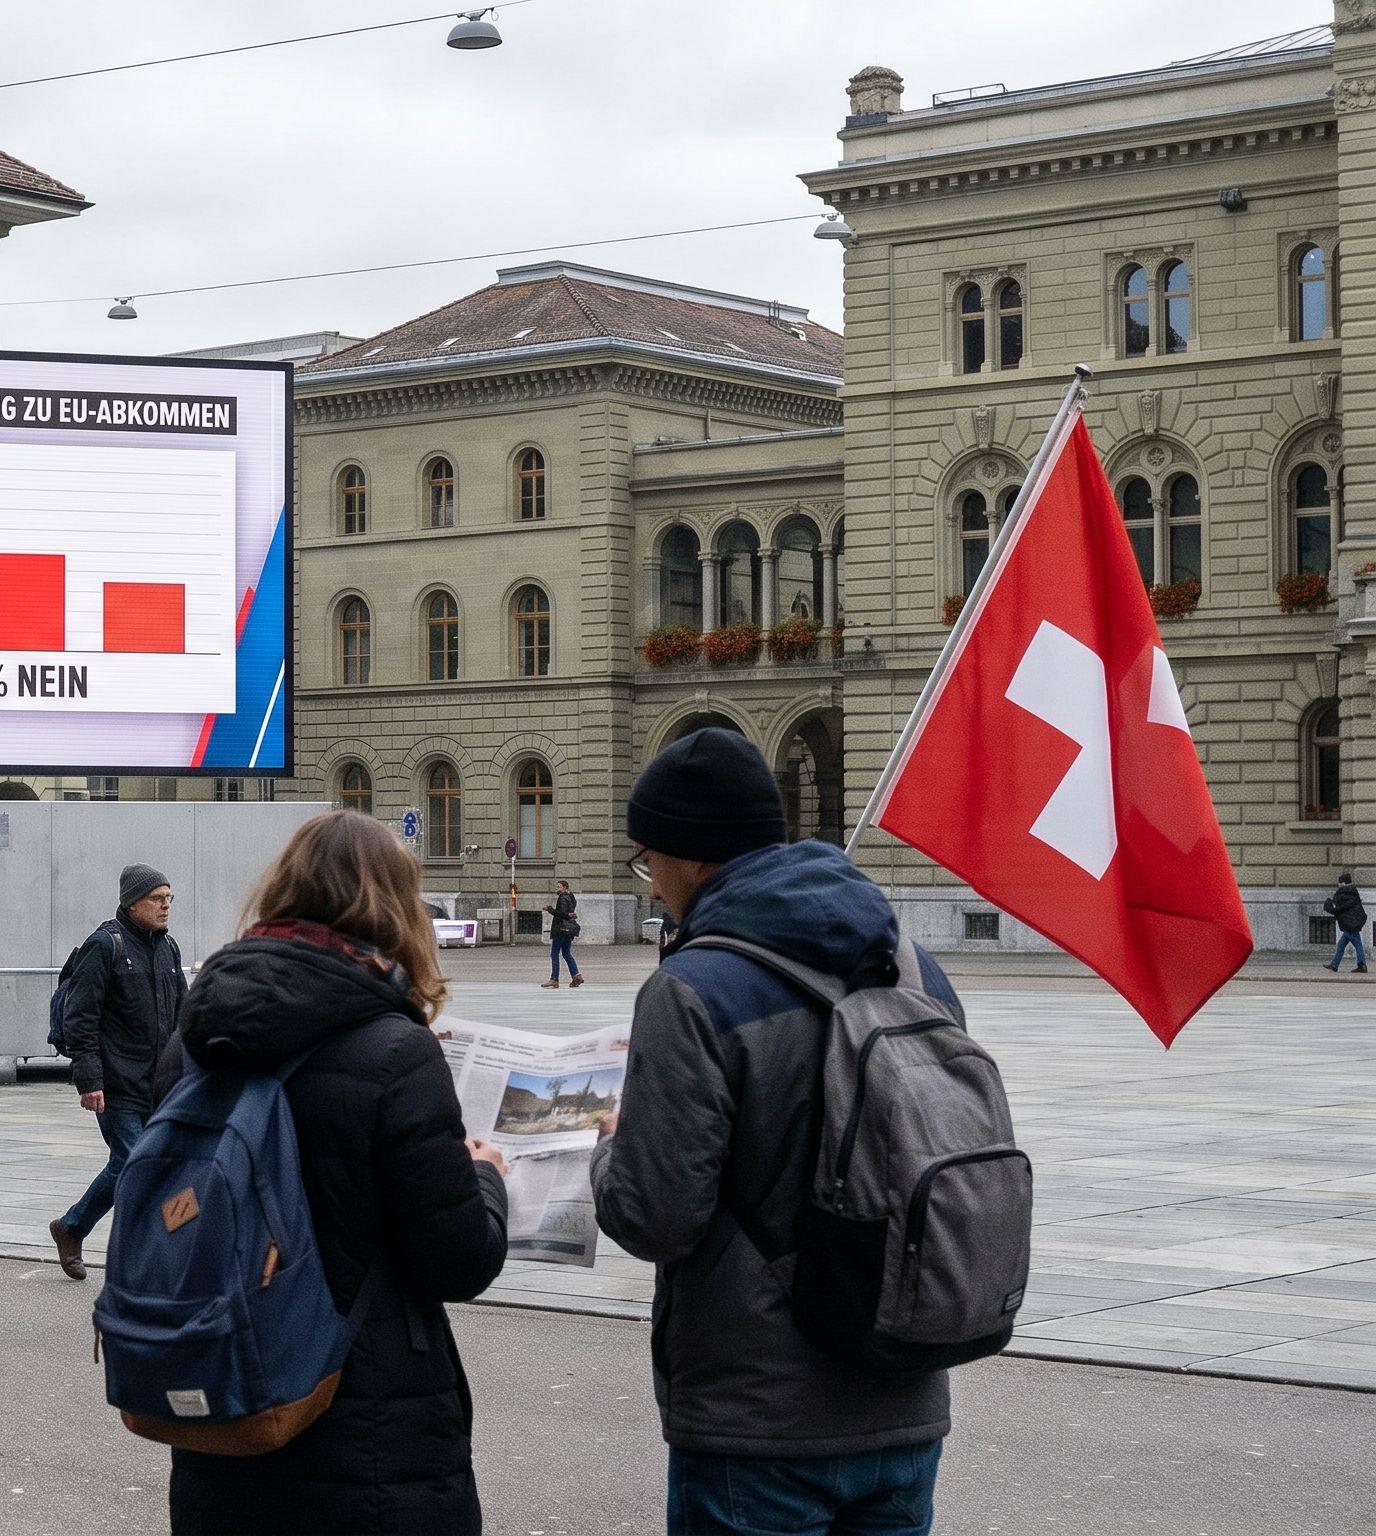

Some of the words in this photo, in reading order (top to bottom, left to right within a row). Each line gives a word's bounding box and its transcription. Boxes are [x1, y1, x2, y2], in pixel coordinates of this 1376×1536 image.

[23, 396, 52, 422] ZU
[59, 397, 231, 429] EU-ABKOMMEN
[18, 664, 88, 699] NEIN
